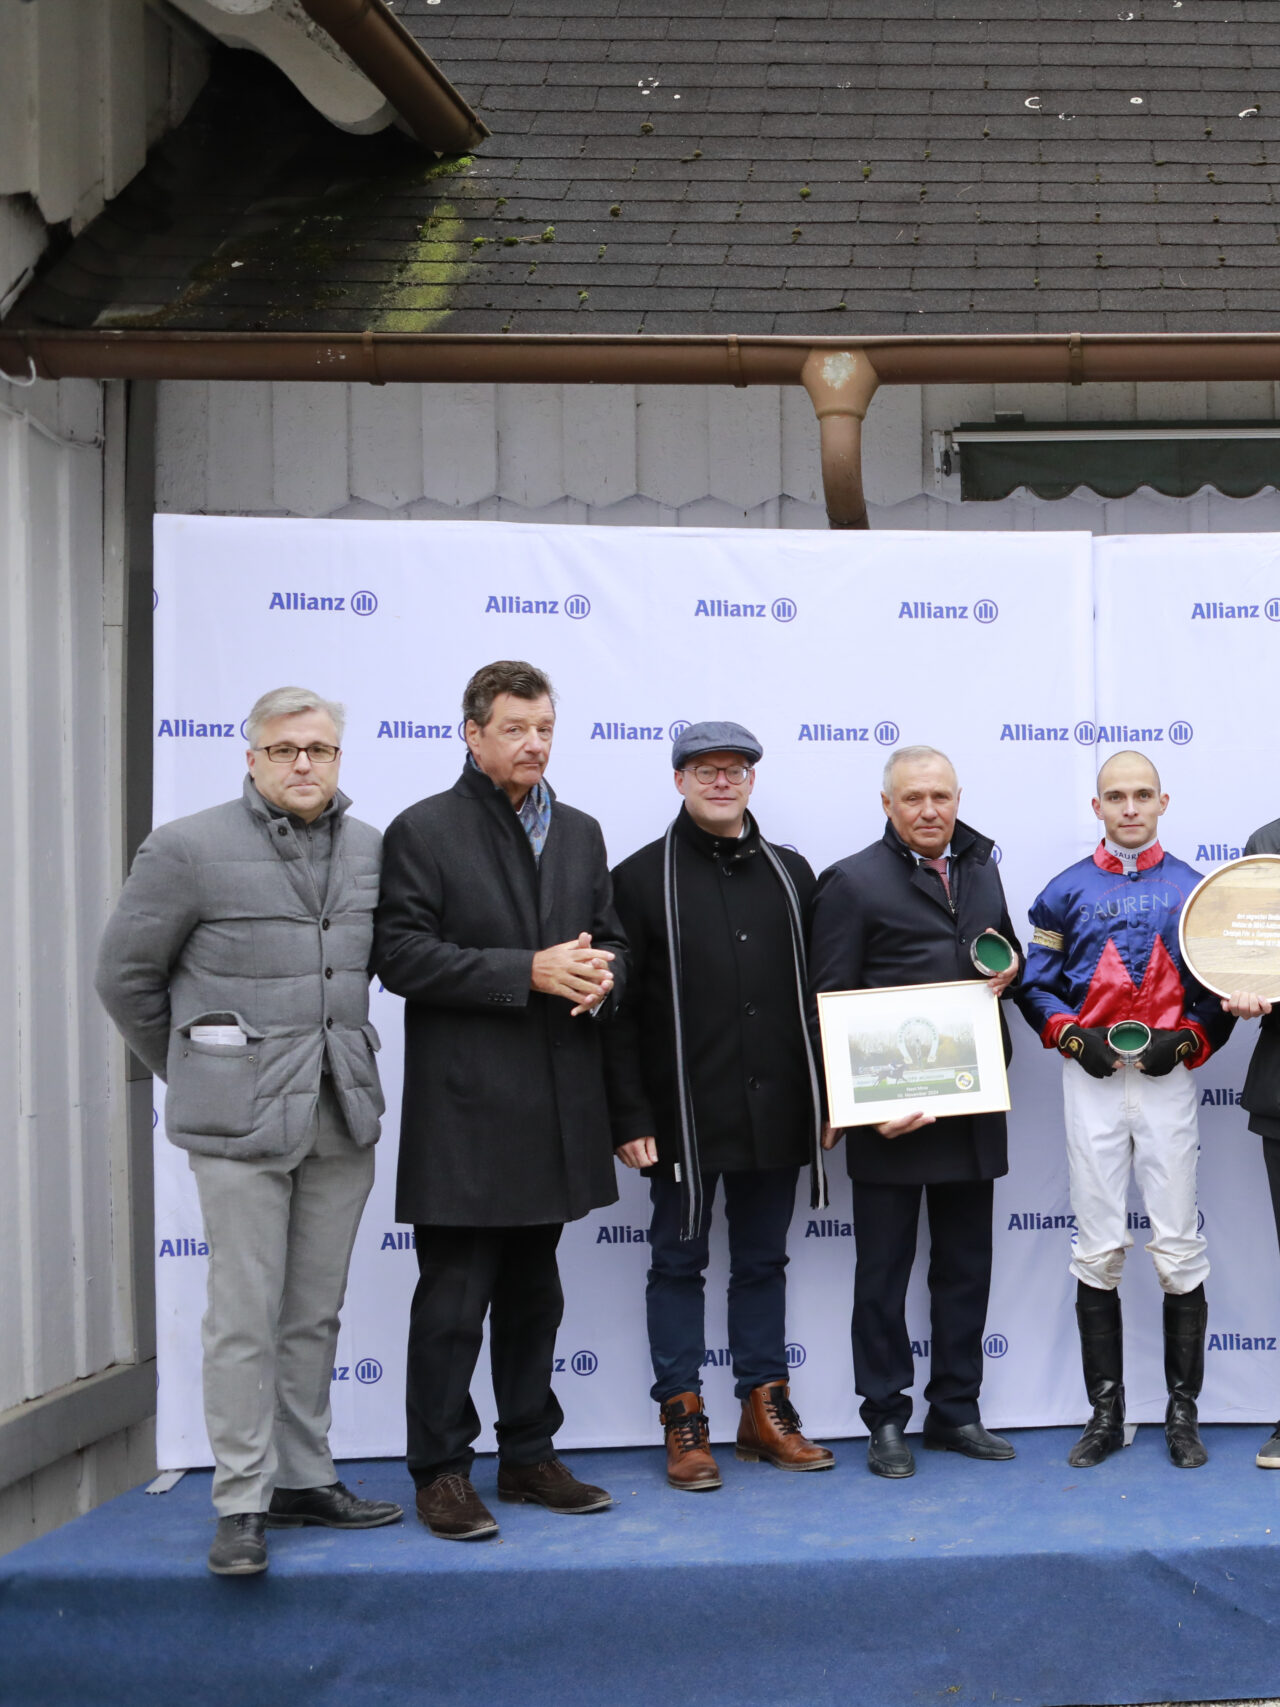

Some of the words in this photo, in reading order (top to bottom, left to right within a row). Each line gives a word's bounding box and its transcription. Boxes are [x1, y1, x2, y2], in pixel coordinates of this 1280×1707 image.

[269, 592, 345, 611] Allianz
[485, 595, 559, 615] Allianz
[695, 599, 767, 618] Allianz
[899, 602, 969, 619] Allianz
[1192, 601, 1260, 619] Allianz
[158, 719, 235, 739] Allianz
[377, 720, 453, 739] Allianz
[591, 722, 664, 741] Allianz
[798, 724, 870, 742] Allianz
[1000, 724, 1070, 742] Allianz
[1097, 726, 1164, 744] Allianz
[1113, 849, 1141, 860] SAUR
[1196, 844, 1246, 862] Allia
[1079, 892, 1169, 923] SAUREN
[1201, 1088, 1244, 1106] Allia
[805, 1220, 854, 1238] Allia
[1007, 1212, 1077, 1232] Allianz
[381, 1231, 416, 1251] Alli
[596, 1225, 650, 1244] Allia
[159, 1237, 210, 1258] Allia
[1207, 1333, 1277, 1352] Allianz
